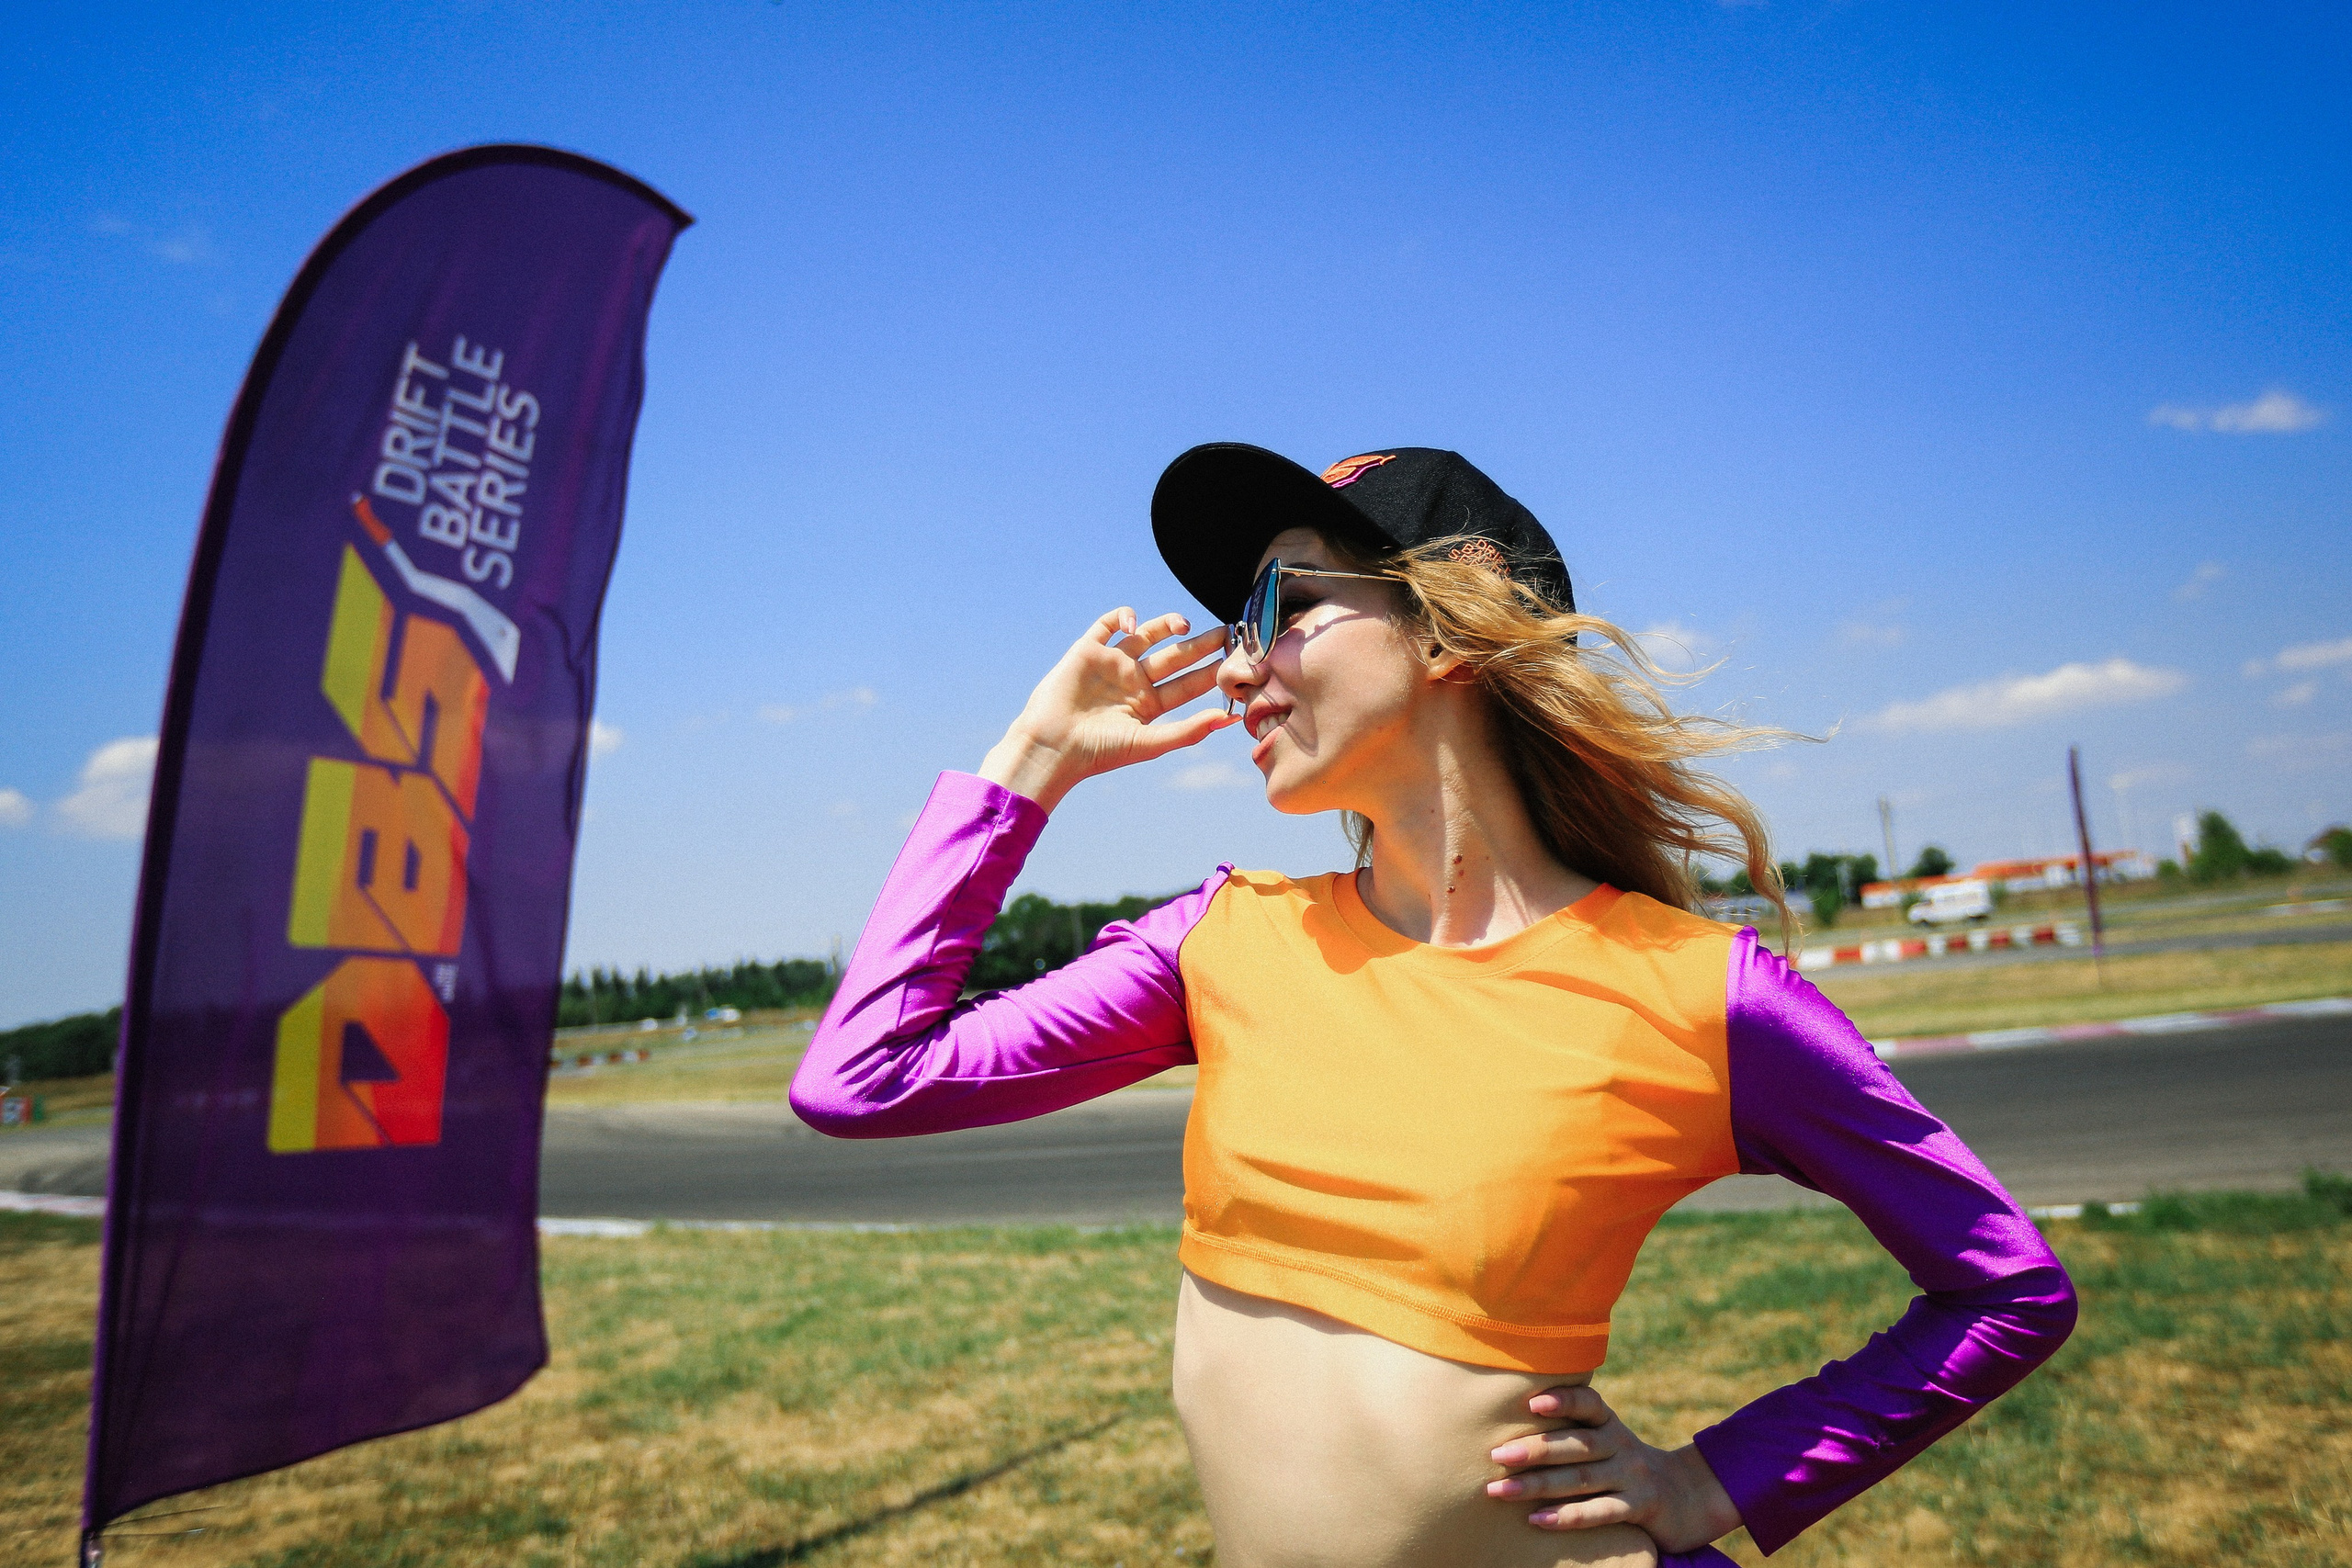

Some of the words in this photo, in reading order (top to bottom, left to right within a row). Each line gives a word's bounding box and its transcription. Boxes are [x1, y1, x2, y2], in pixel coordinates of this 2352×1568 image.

[374, 342, 449, 505] DRIFT
[418, 334, 504, 550] BATTLE
[462, 382, 541, 590] SERIES
[267, 542, 492, 1155] DBS
